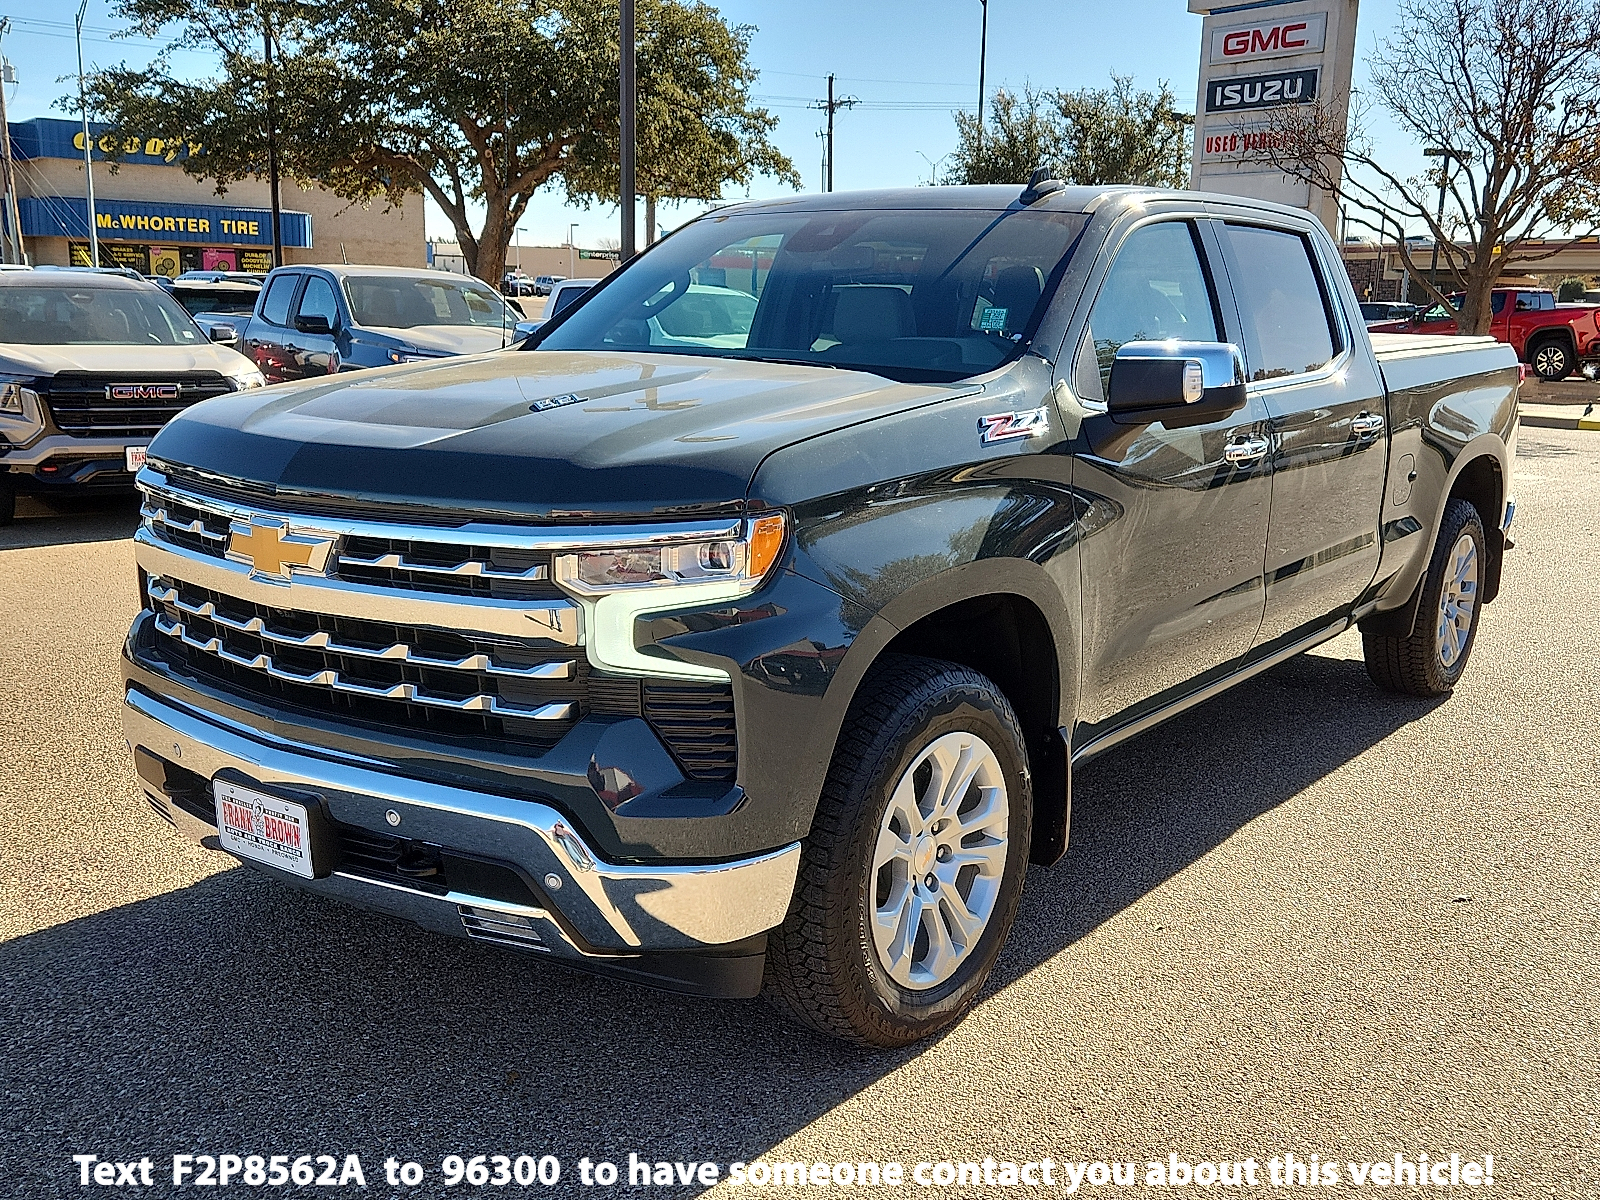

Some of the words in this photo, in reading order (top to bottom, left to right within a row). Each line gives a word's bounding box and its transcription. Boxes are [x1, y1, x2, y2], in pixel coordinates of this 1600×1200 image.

[1223, 23, 1307, 56] GMC
[1215, 77, 1303, 106] ISUZU
[1206, 134, 1237, 153] USED
[96, 214, 210, 233] McWHORTER
[220, 219, 259, 235] TIRE
[113, 386, 177, 399] GMC
[222, 802, 254, 832] FRANK
[264, 815, 301, 848] BROWN
